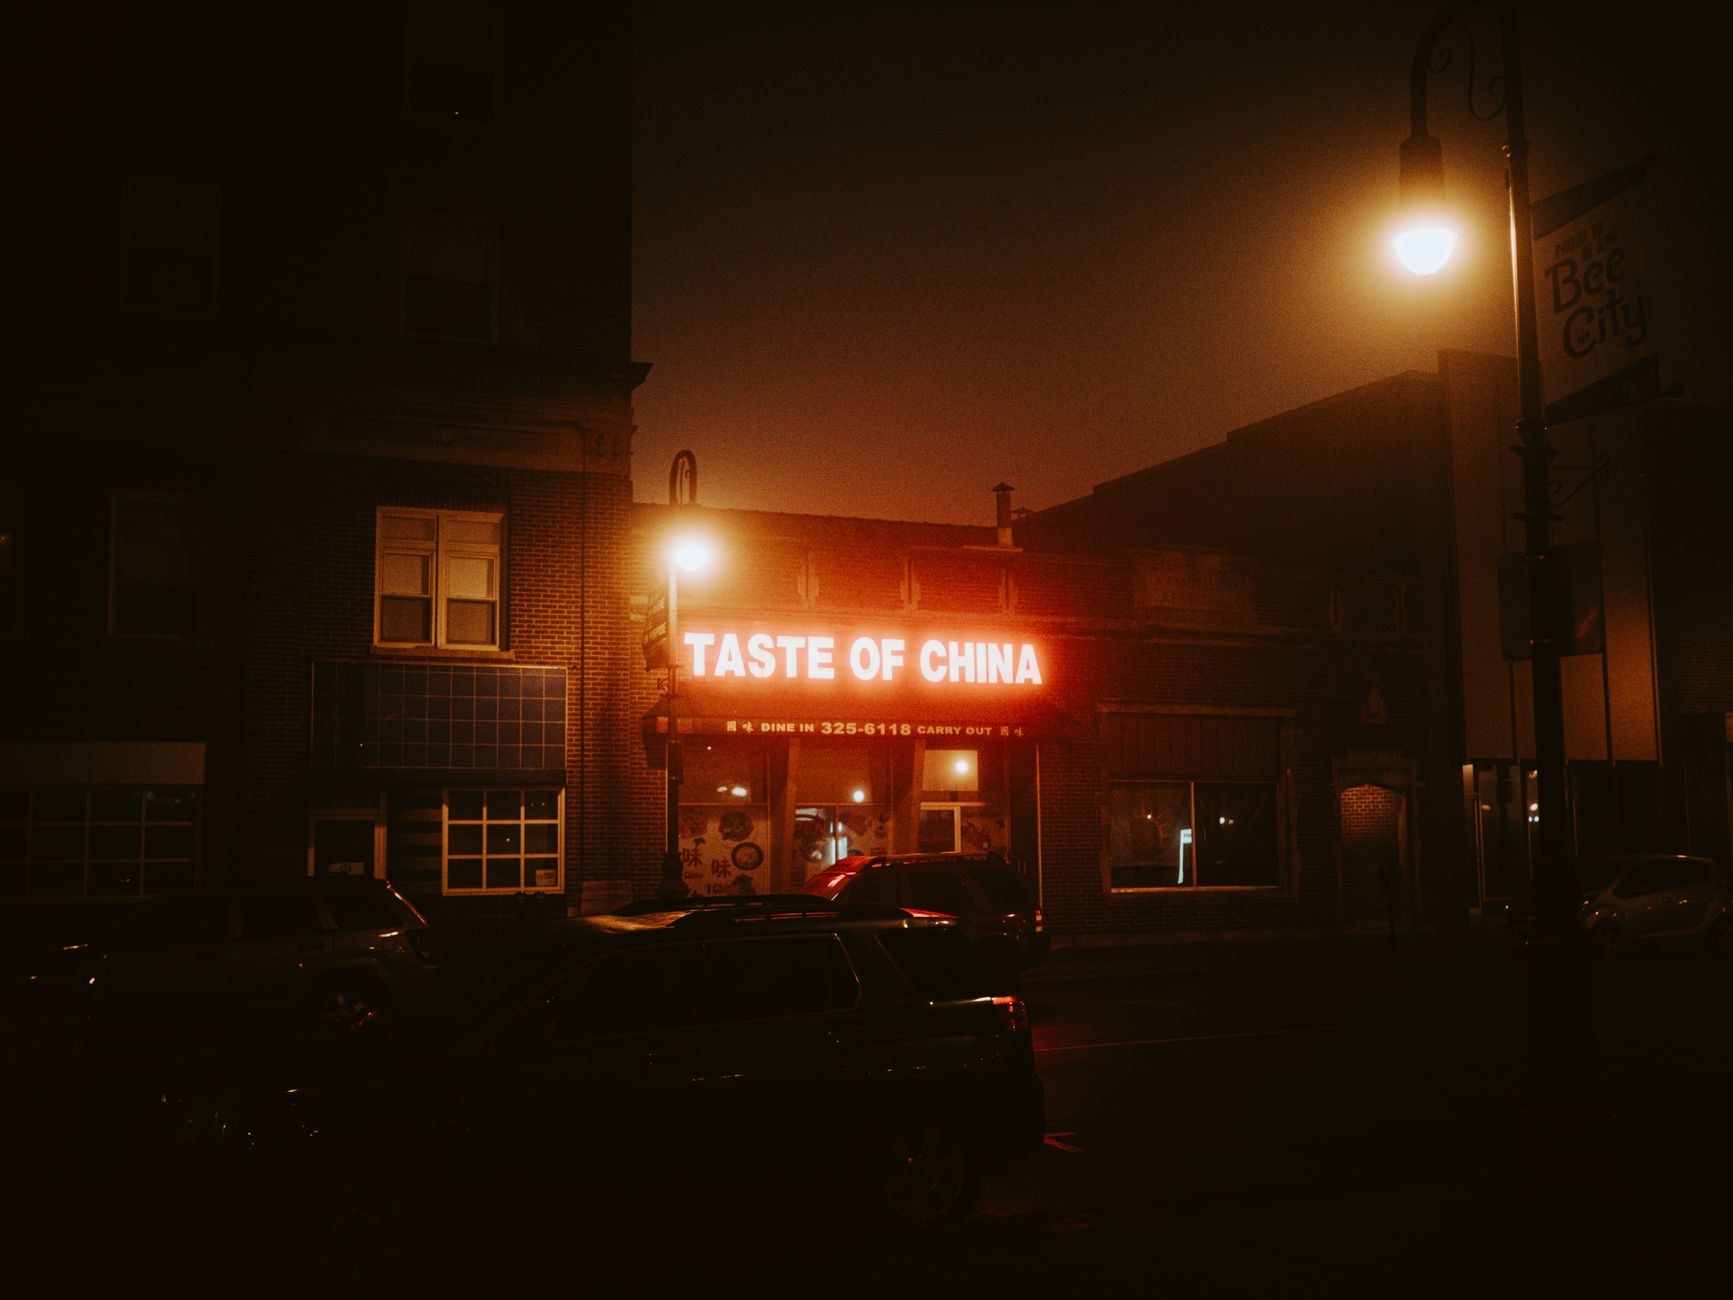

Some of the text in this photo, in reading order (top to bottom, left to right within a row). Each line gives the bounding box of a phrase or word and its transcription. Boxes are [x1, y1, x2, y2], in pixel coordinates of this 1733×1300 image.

[1545, 247, 1626, 315] Bee
[1563, 289, 1647, 359] City
[685, 633, 1043, 685] TASTE OF CHINA
[760, 721, 992, 736] DINE IN 325-6118 CARRY OUT
